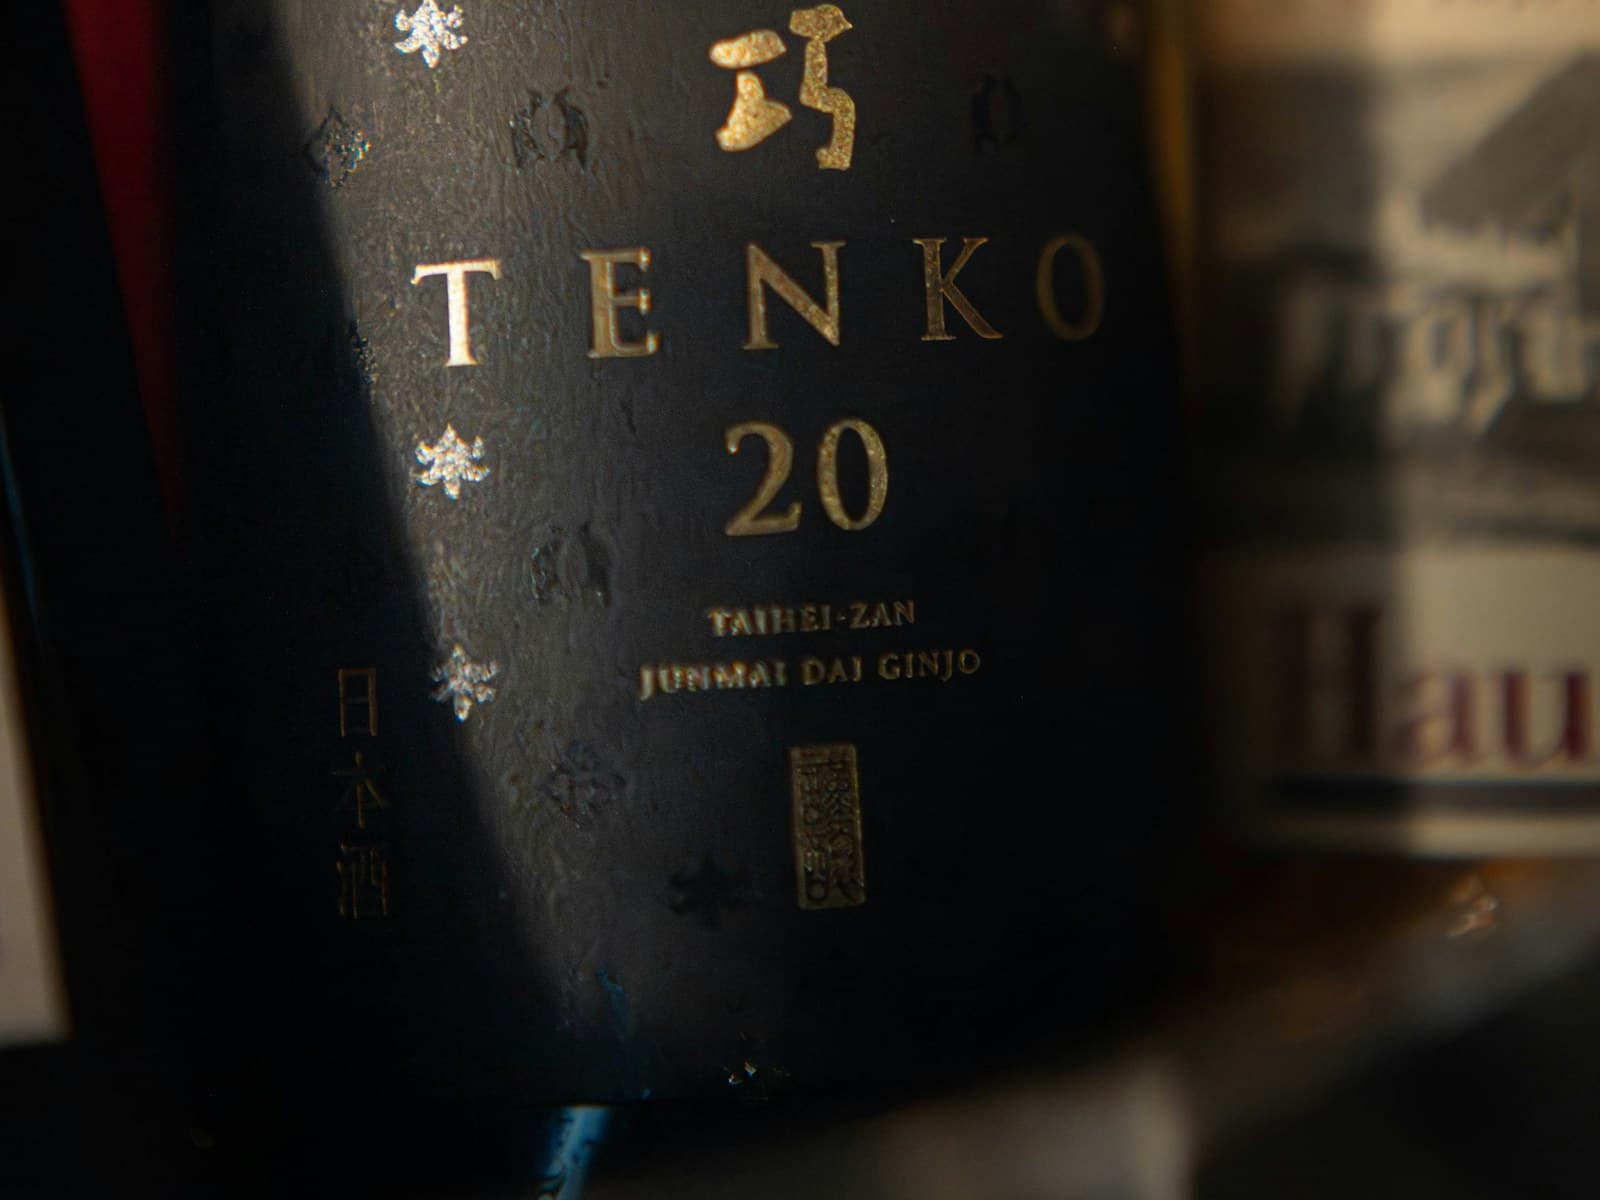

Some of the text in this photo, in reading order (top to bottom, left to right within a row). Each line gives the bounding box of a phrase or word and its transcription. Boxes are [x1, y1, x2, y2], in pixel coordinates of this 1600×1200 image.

[411, 232, 1106, 368] TENKO
[724, 416, 890, 536] 20
[639, 660, 788, 701] JUNMAI
[877, 648, 983, 684] GINJO
